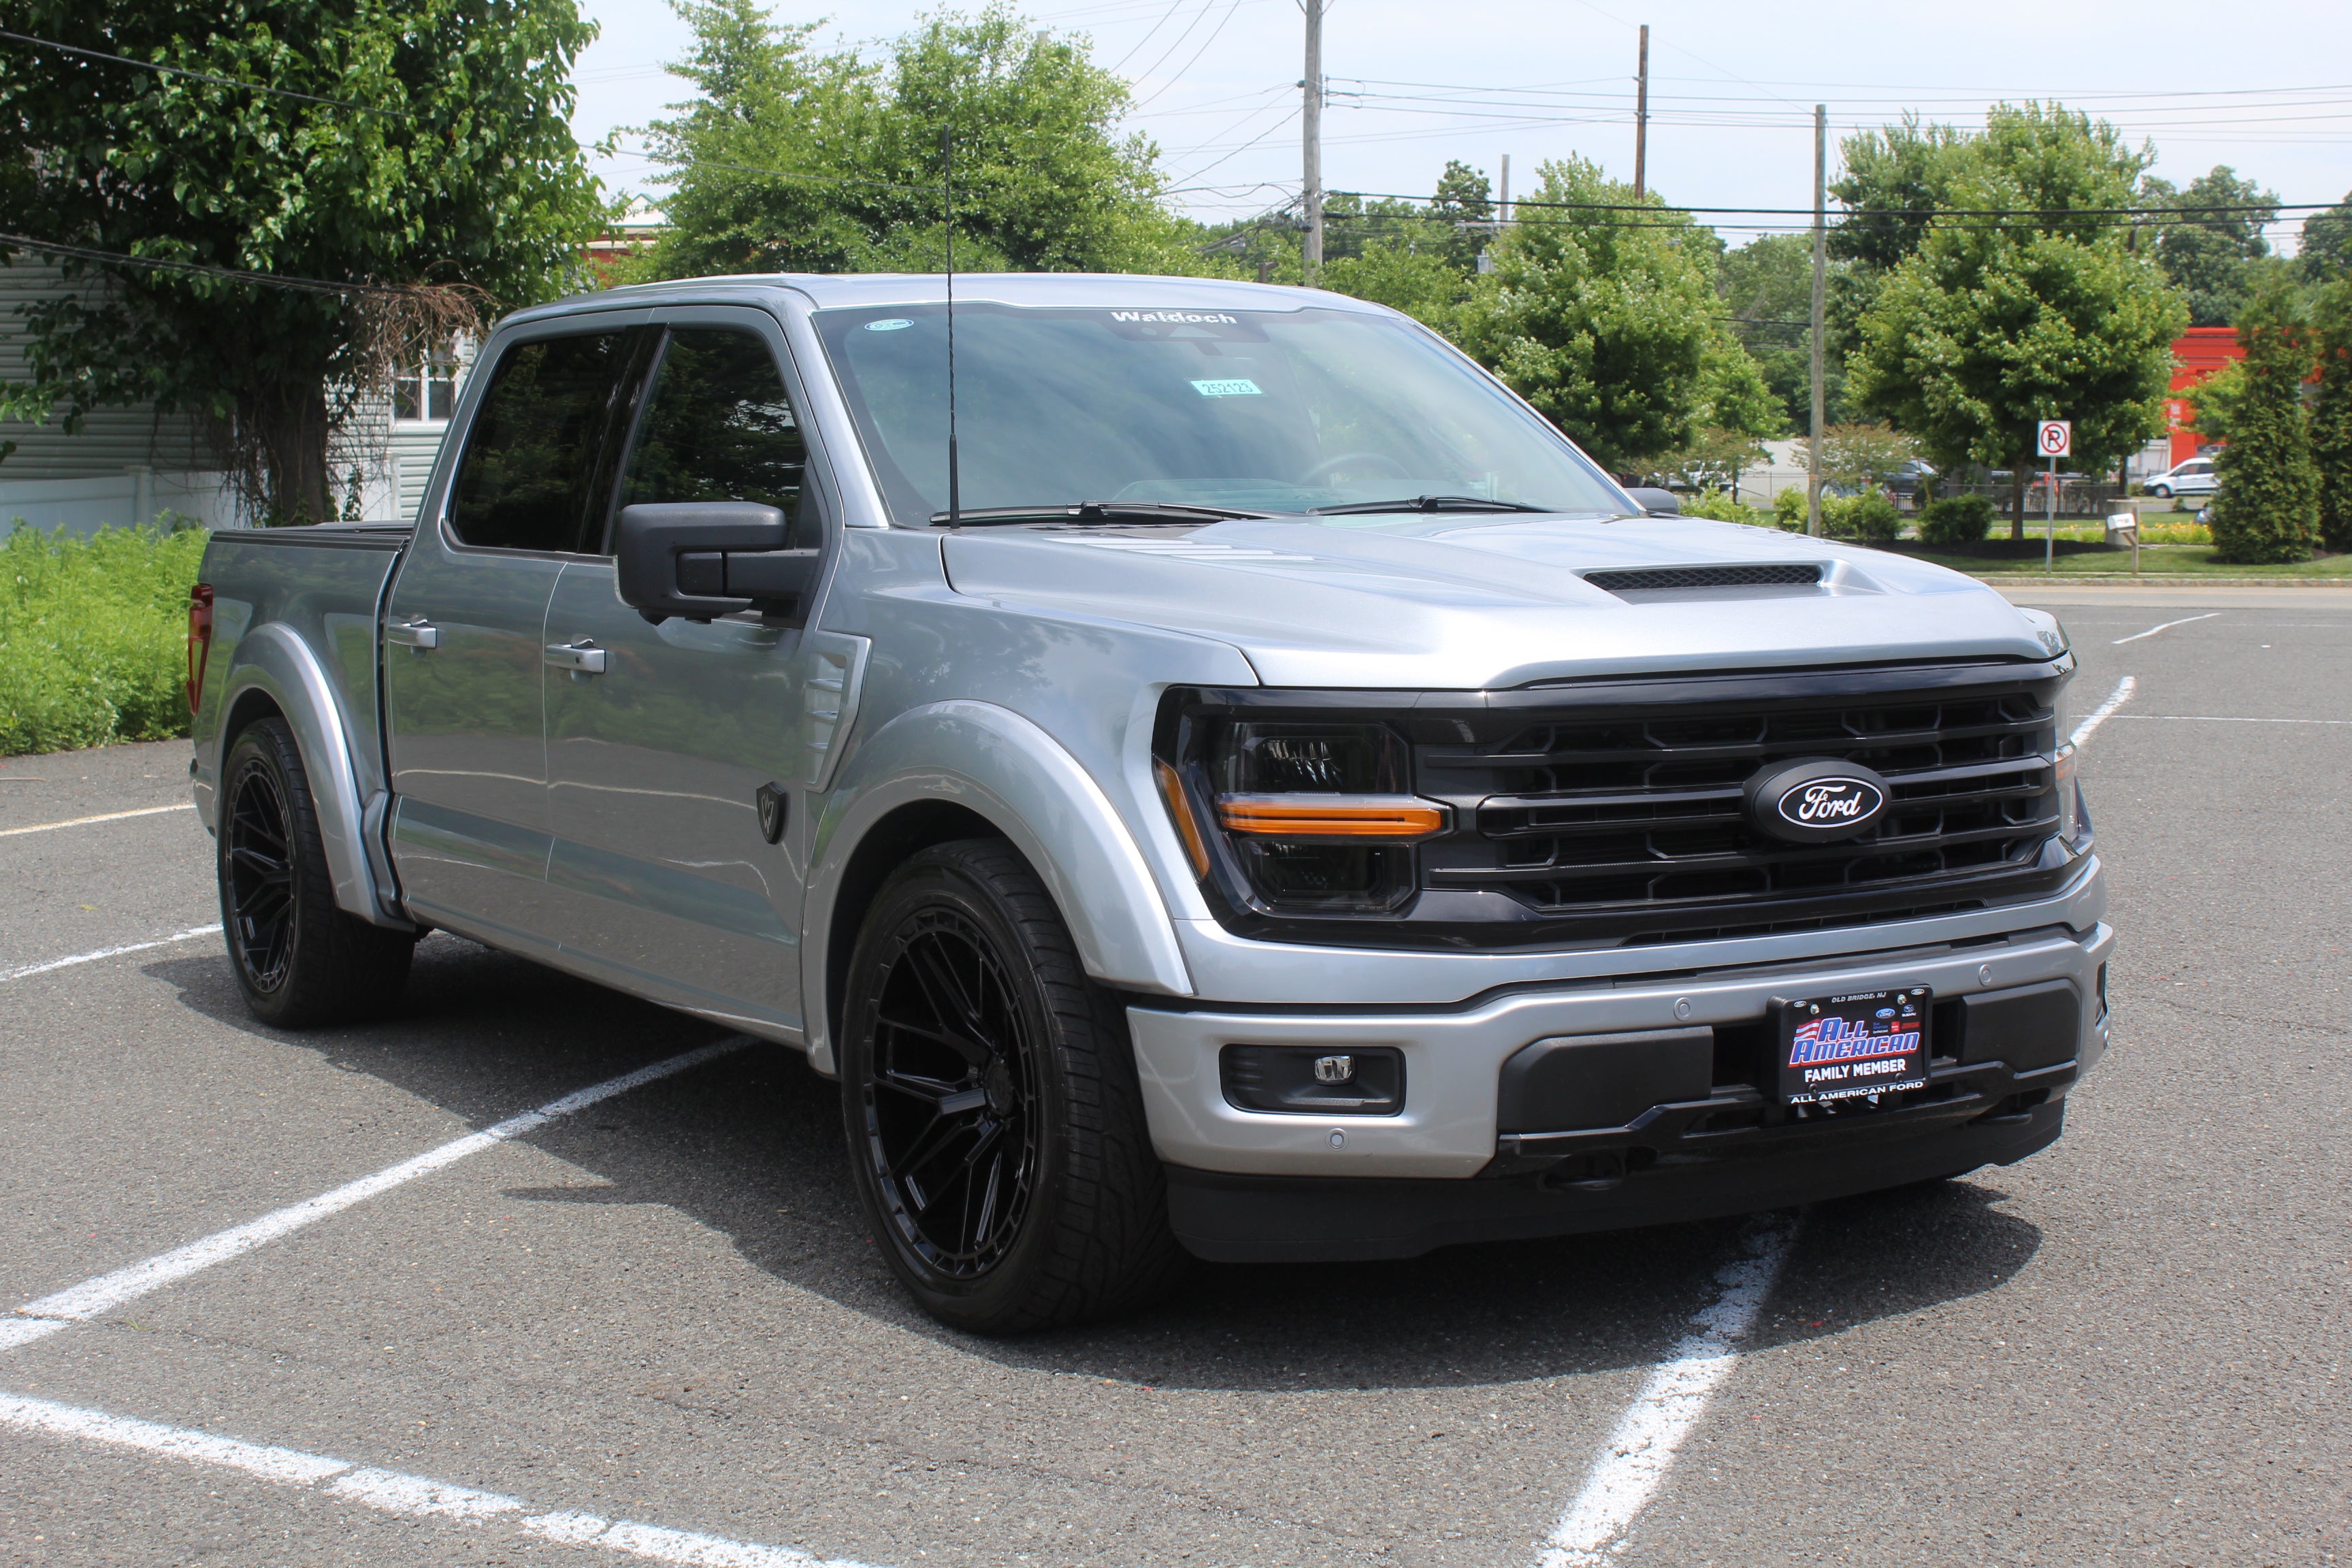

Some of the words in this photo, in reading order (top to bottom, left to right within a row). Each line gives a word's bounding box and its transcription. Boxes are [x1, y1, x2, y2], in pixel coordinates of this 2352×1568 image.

[1110, 311, 1237, 325] Waldoch
[1201, 382, 1254, 394] 252123
[1798, 785, 1862, 820] Ford
[1804, 1065, 1850, 1083] FAMILY
[1852, 1058, 1906, 1077] MEMBER
[1791, 1094, 1816, 1104] ALL
[1818, 1086, 1886, 1101] AMERICAN
[1889, 1081, 1924, 1092] FORD
